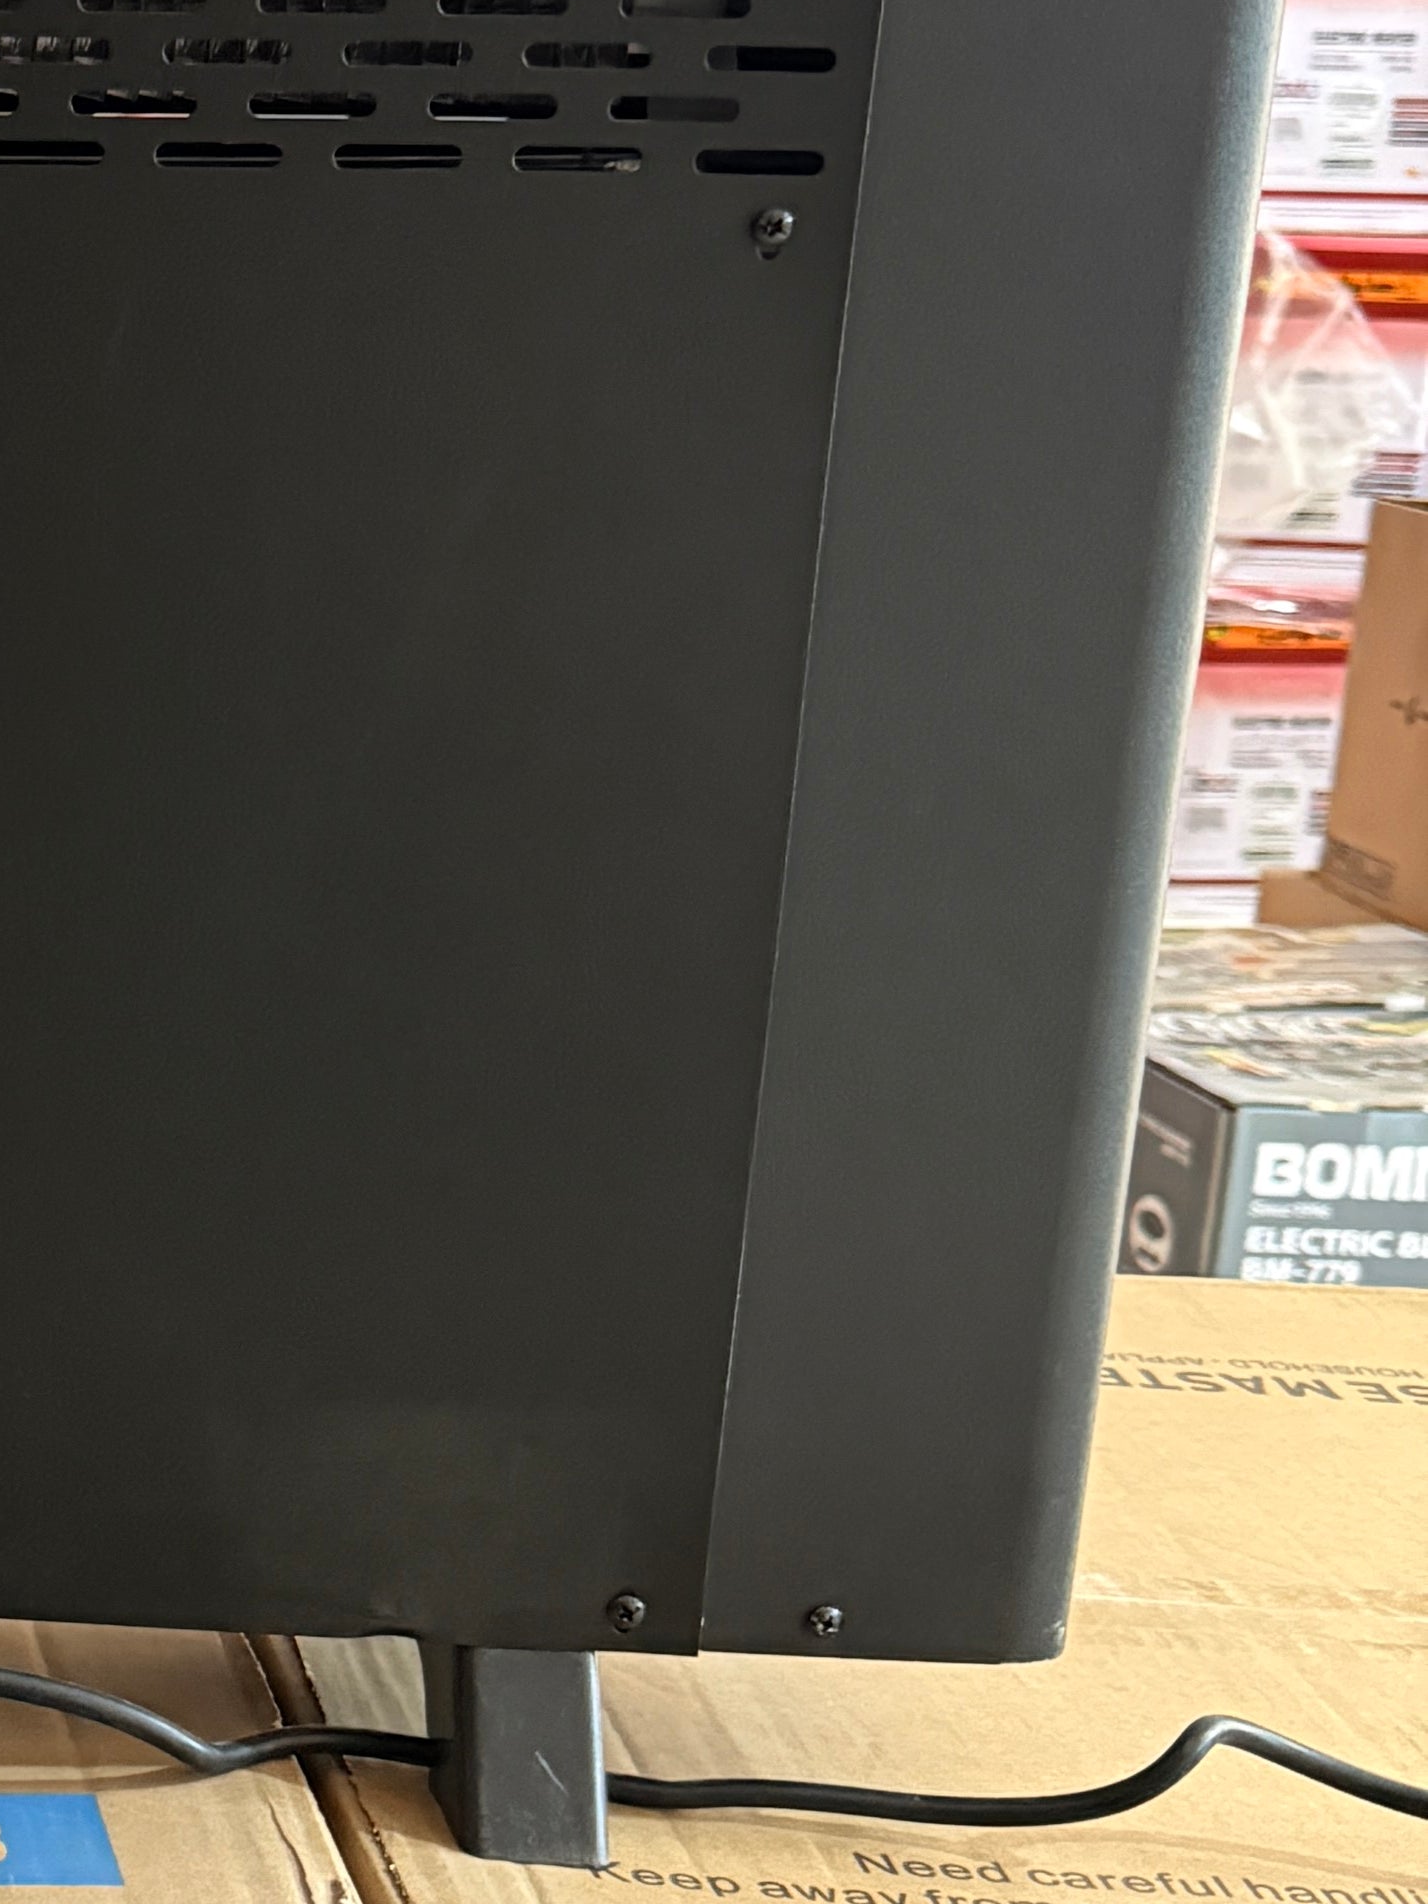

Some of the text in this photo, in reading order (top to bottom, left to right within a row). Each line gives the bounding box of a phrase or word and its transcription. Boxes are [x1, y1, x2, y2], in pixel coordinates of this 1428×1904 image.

[1244, 1226, 1394, 1259] ELECTRIC
[852, 1850, 1010, 1886] Need
[1025, 1862, 1232, 1901] careful
